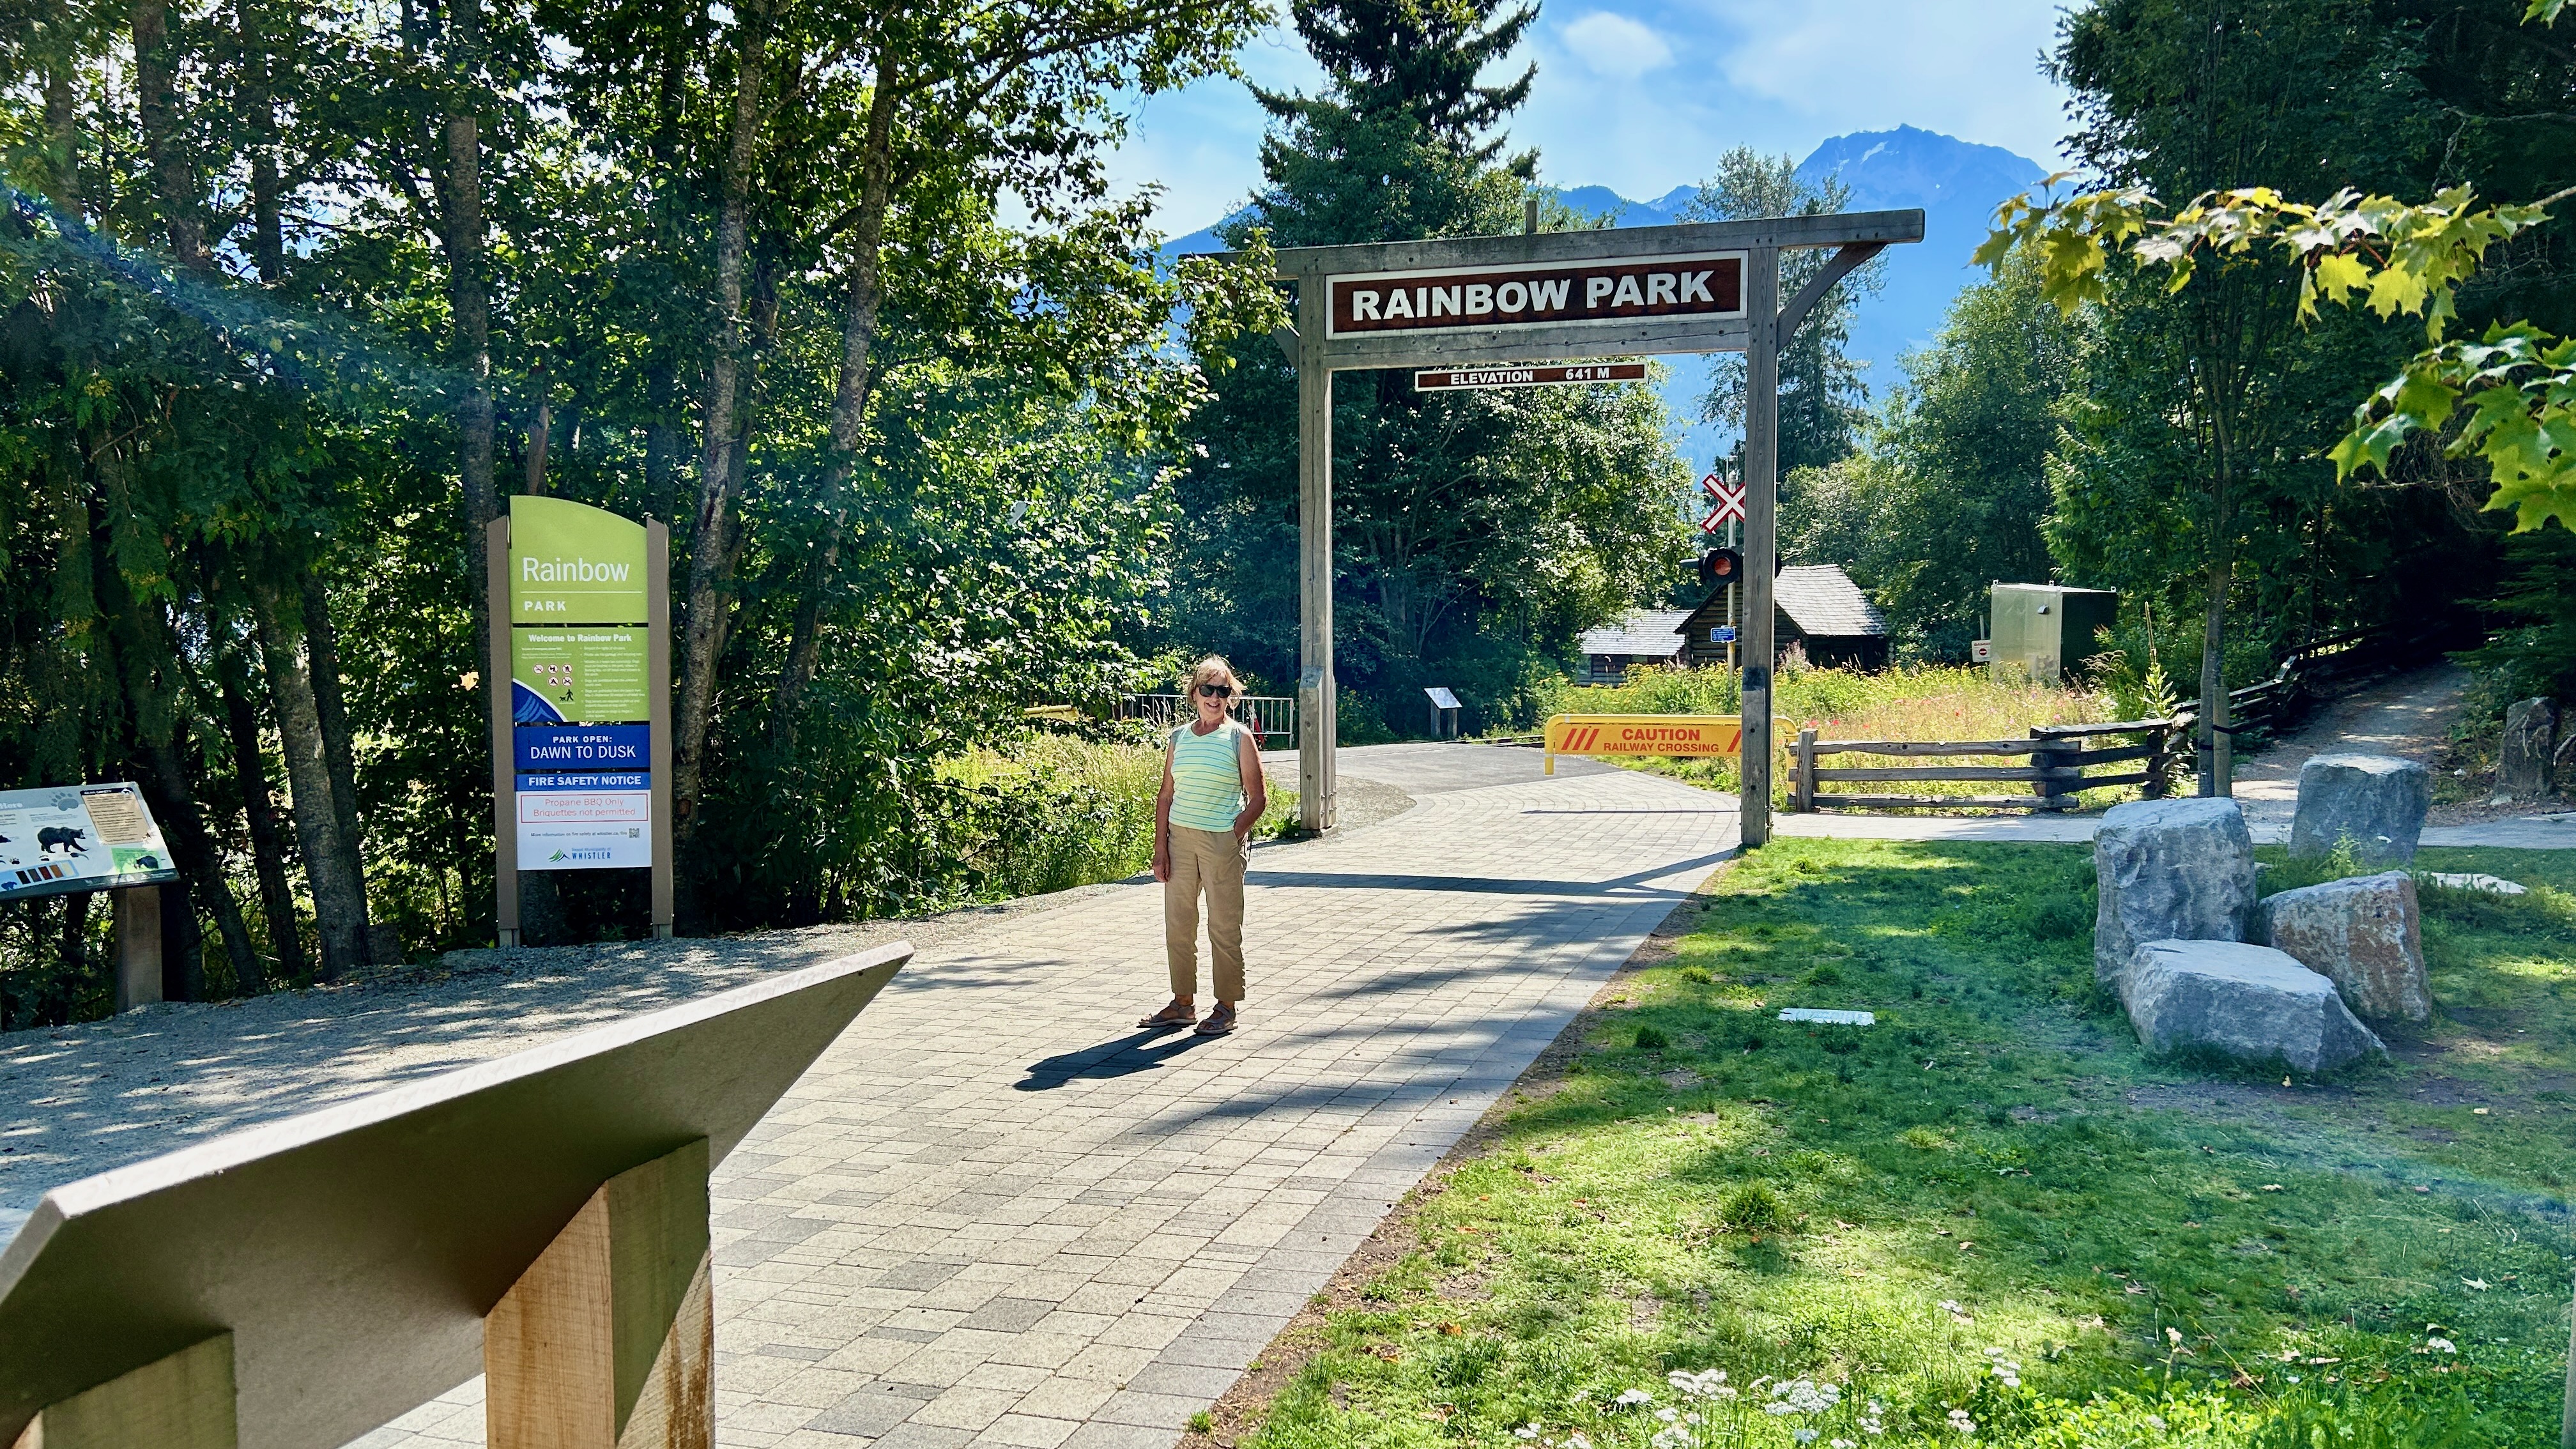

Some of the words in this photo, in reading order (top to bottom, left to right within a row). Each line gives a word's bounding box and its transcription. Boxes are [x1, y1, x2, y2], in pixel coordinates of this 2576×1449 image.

[1353, 279, 1571, 321] RAINBOW
[1586, 270, 1715, 309] PARK
[1450, 371, 1533, 385] ELEVATION
[1565, 368, 1591, 380] 641
[1597, 367, 1610, 379] M
[523, 557, 630, 582] Rainbow
[524, 601, 567, 611] PARK
[528, 634, 565, 642] Welcome
[567, 634, 576, 642] to
[577, 634, 612, 642] Rainbow
[613, 634, 632, 642] Park
[1621, 728, 1701, 741] CAUTION
[530, 746, 571, 759] DAWN
[575, 746, 593, 758] TO
[598, 745, 636, 758] DUSK
[1604, 742, 1653, 751] RAILWAY
[1657, 742, 1719, 752] CROSSING
[528, 776, 555, 786] FIRE
[557, 776, 599, 786] SAFETY
[601, 776, 641, 785] NOTICE
[545, 799, 581, 807] Propane
[584, 798, 602, 806] BBQ
[605, 798, 624, 806] Only
[533, 809, 577, 817] Briquettes
[595, 808, 635, 816] permitted
